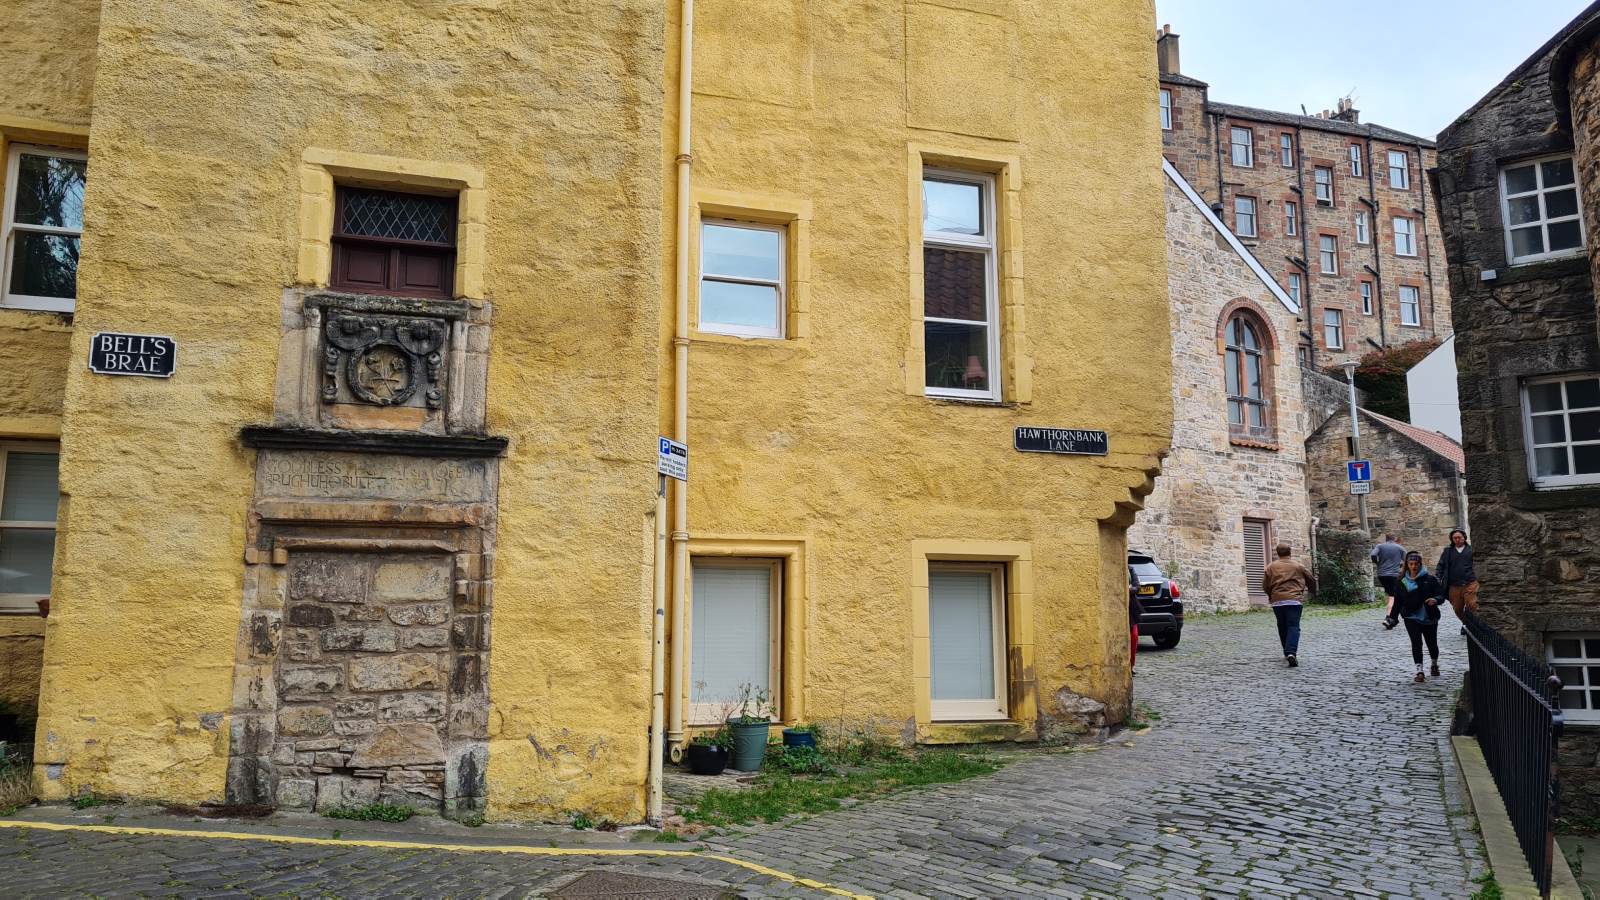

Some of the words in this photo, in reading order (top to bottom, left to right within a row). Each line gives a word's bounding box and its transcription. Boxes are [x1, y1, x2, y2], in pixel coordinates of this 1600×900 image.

[101, 335, 166, 356] BELL'S
[105, 353, 161, 373] BRAE
[1019, 428, 1104, 442] HAWTHORNBANK
[662, 440, 669, 452] P
[1049, 440, 1076, 451] LANE
